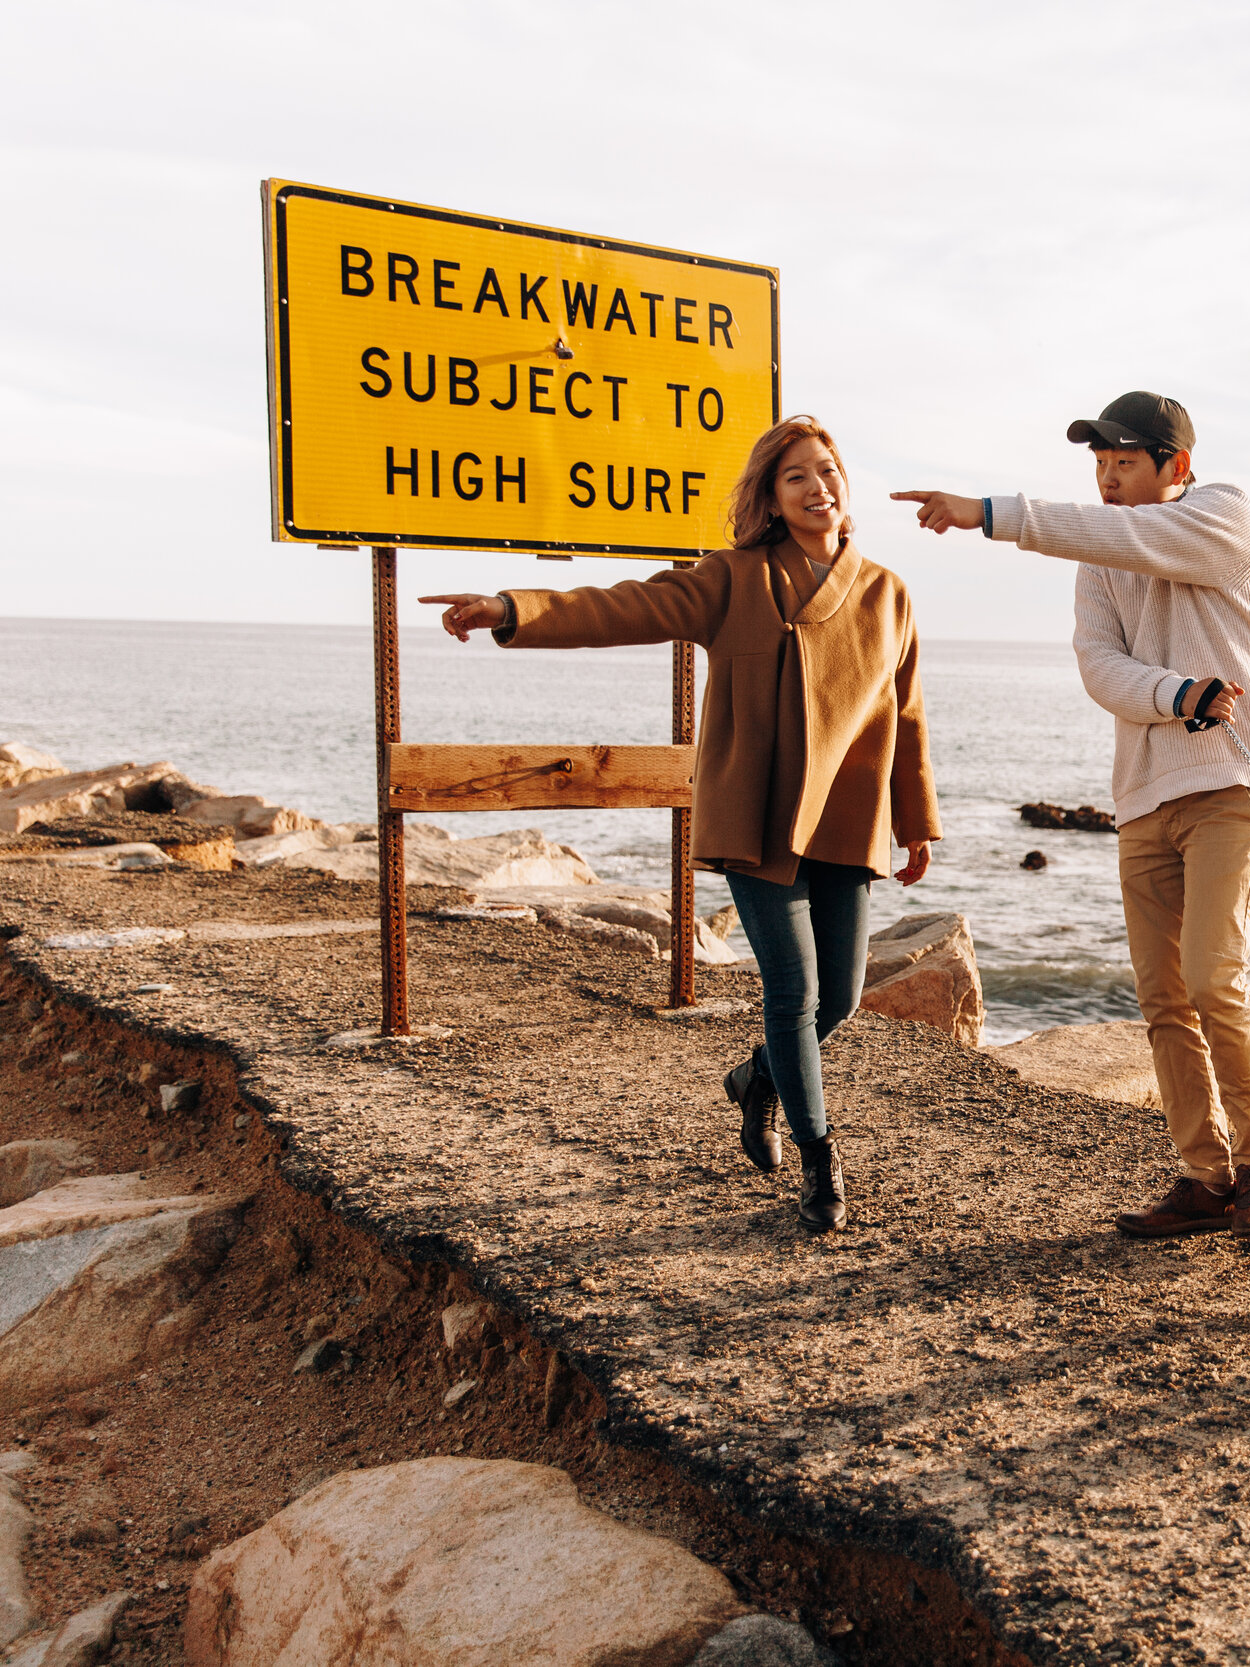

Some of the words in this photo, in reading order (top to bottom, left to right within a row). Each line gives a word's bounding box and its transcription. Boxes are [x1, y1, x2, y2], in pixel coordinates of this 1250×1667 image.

[340, 244, 734, 350] BREAKWATER
[359, 346, 628, 422] SUBJECT
[666, 383, 725, 433] TO
[385, 446, 527, 504] HIGH
[568, 460, 707, 515] SURF
